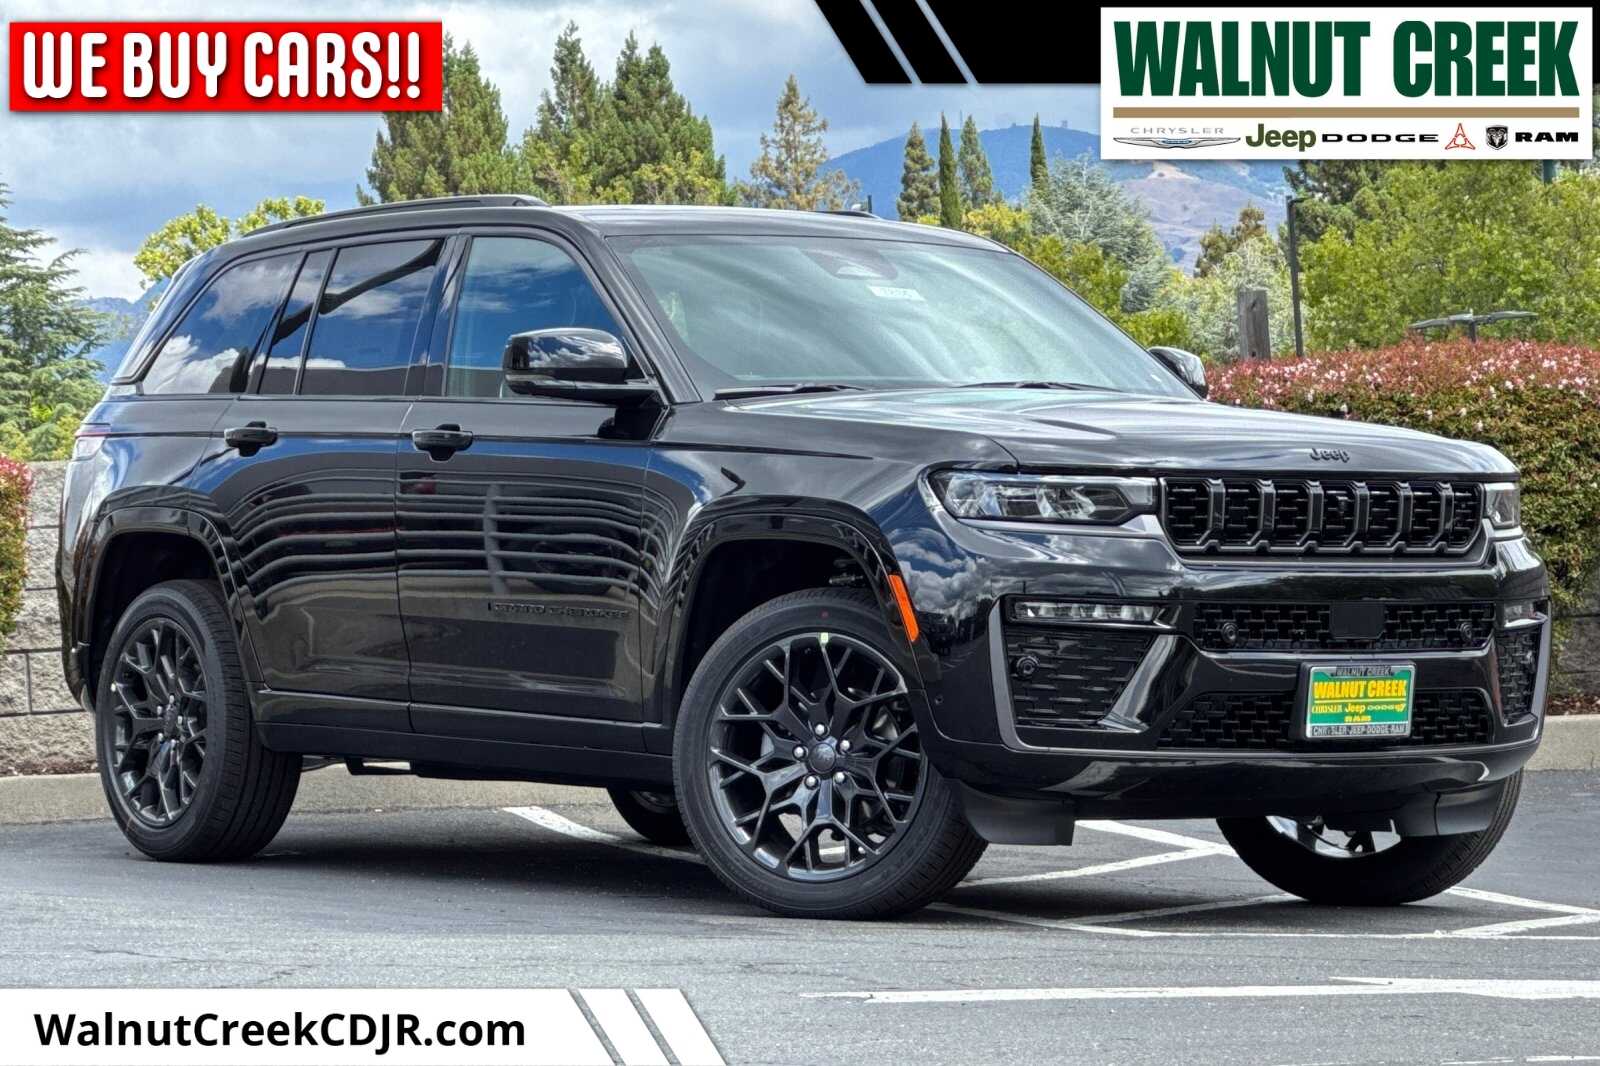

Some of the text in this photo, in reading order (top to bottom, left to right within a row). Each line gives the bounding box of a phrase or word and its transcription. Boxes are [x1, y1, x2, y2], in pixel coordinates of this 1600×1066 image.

[1310, 447, 1350, 463] Jeep
[1313, 680, 1407, 699] WALNUT CREEK
[1344, 702, 1366, 714] Jeep
